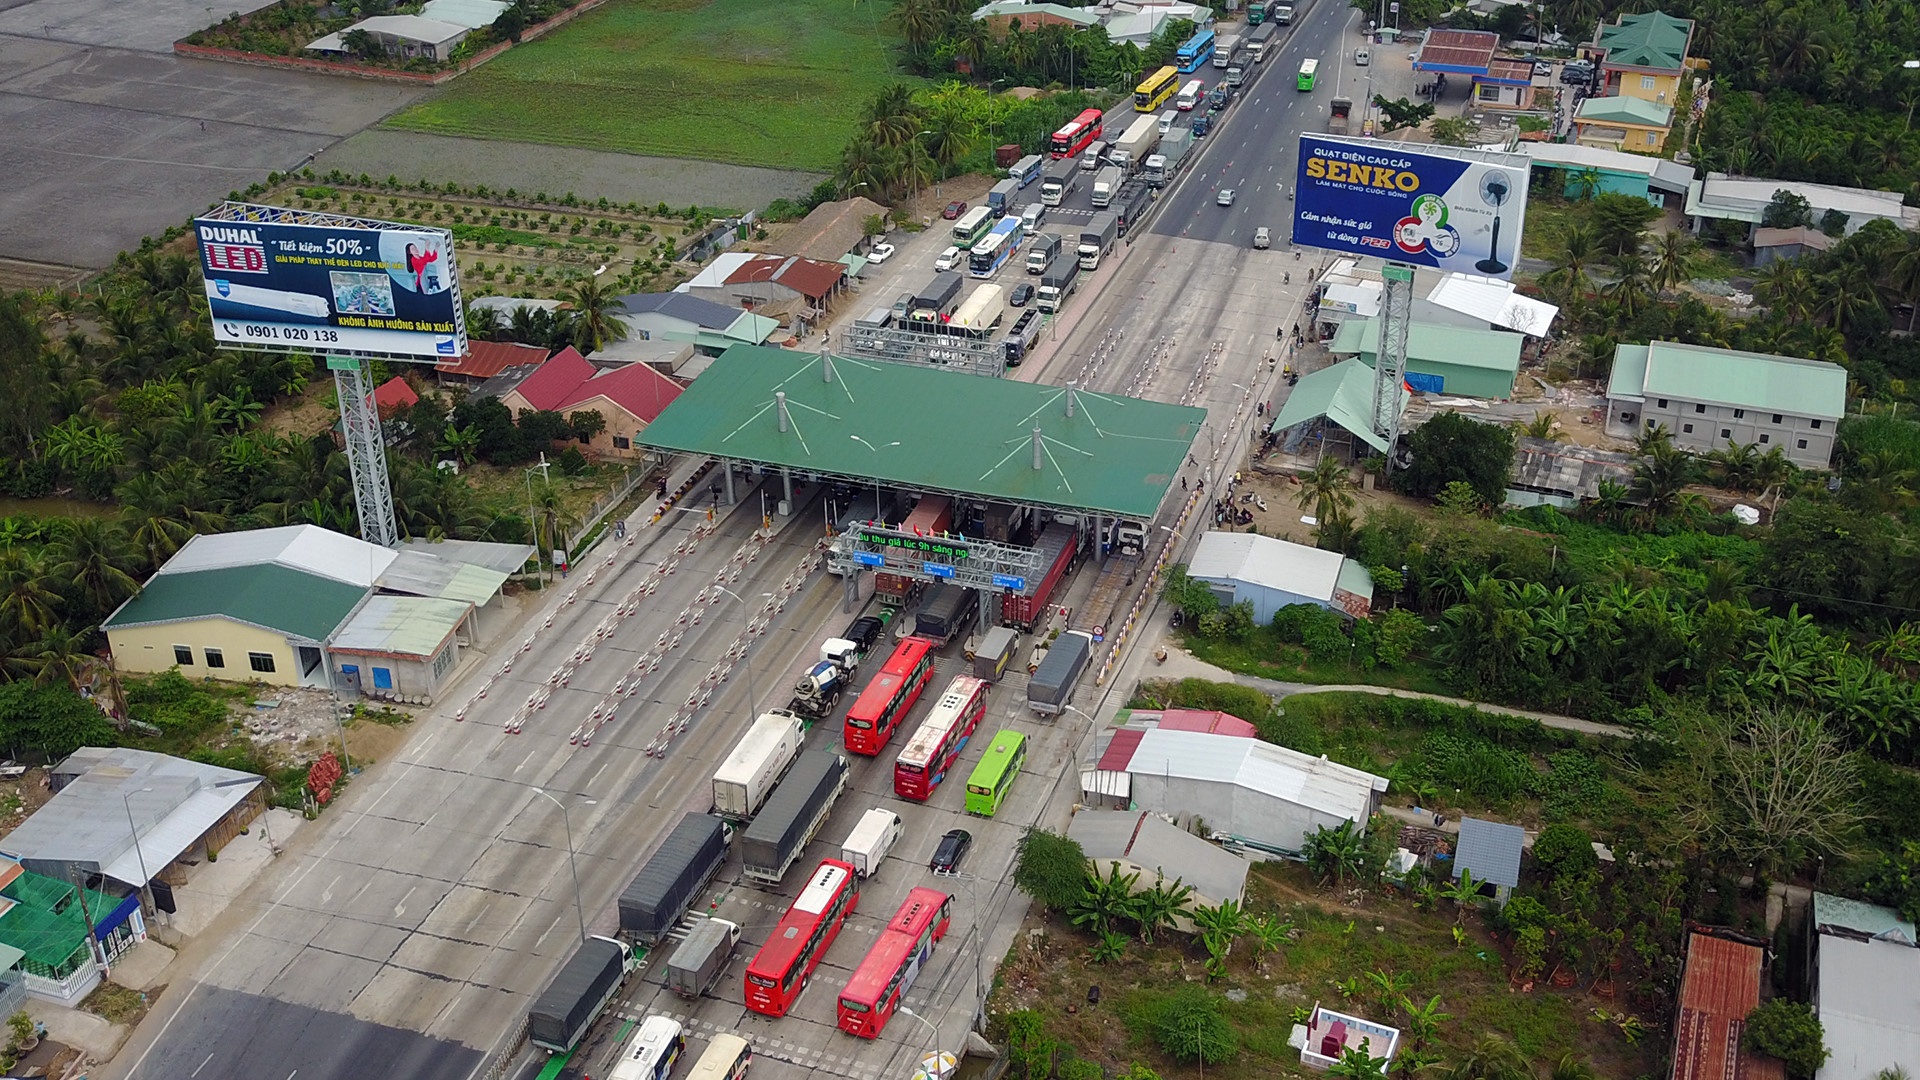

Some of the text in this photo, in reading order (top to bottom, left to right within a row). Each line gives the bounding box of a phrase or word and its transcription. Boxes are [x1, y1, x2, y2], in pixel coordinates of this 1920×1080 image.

[1314, 148, 1341, 159] QUẠT
[1342, 152, 1366, 162] ĐIỆN
[1367, 156, 1389, 166] CAO
[1306, 157, 1419, 192] SENKO
[1320, 215, 1342, 226] nhận
[199, 226, 263, 245] DUHAL
[1360, 236, 1392, 249] F23
[325, 238, 363, 255] 50%
[208, 244, 263, 271] LED
[306, 257, 322, 265] THAY
[338, 315, 454, 333] KHÔNG ẢNH HƯỞNG SẢN XUẤT
[245, 325, 339, 342] 0901 020 138
[871, 534, 886, 544] thu
[889, 536, 901, 549] giá
[903, 539, 917, 549] lúc
[918, 541, 930, 551] 9h
[932, 545, 953, 557] sáng
